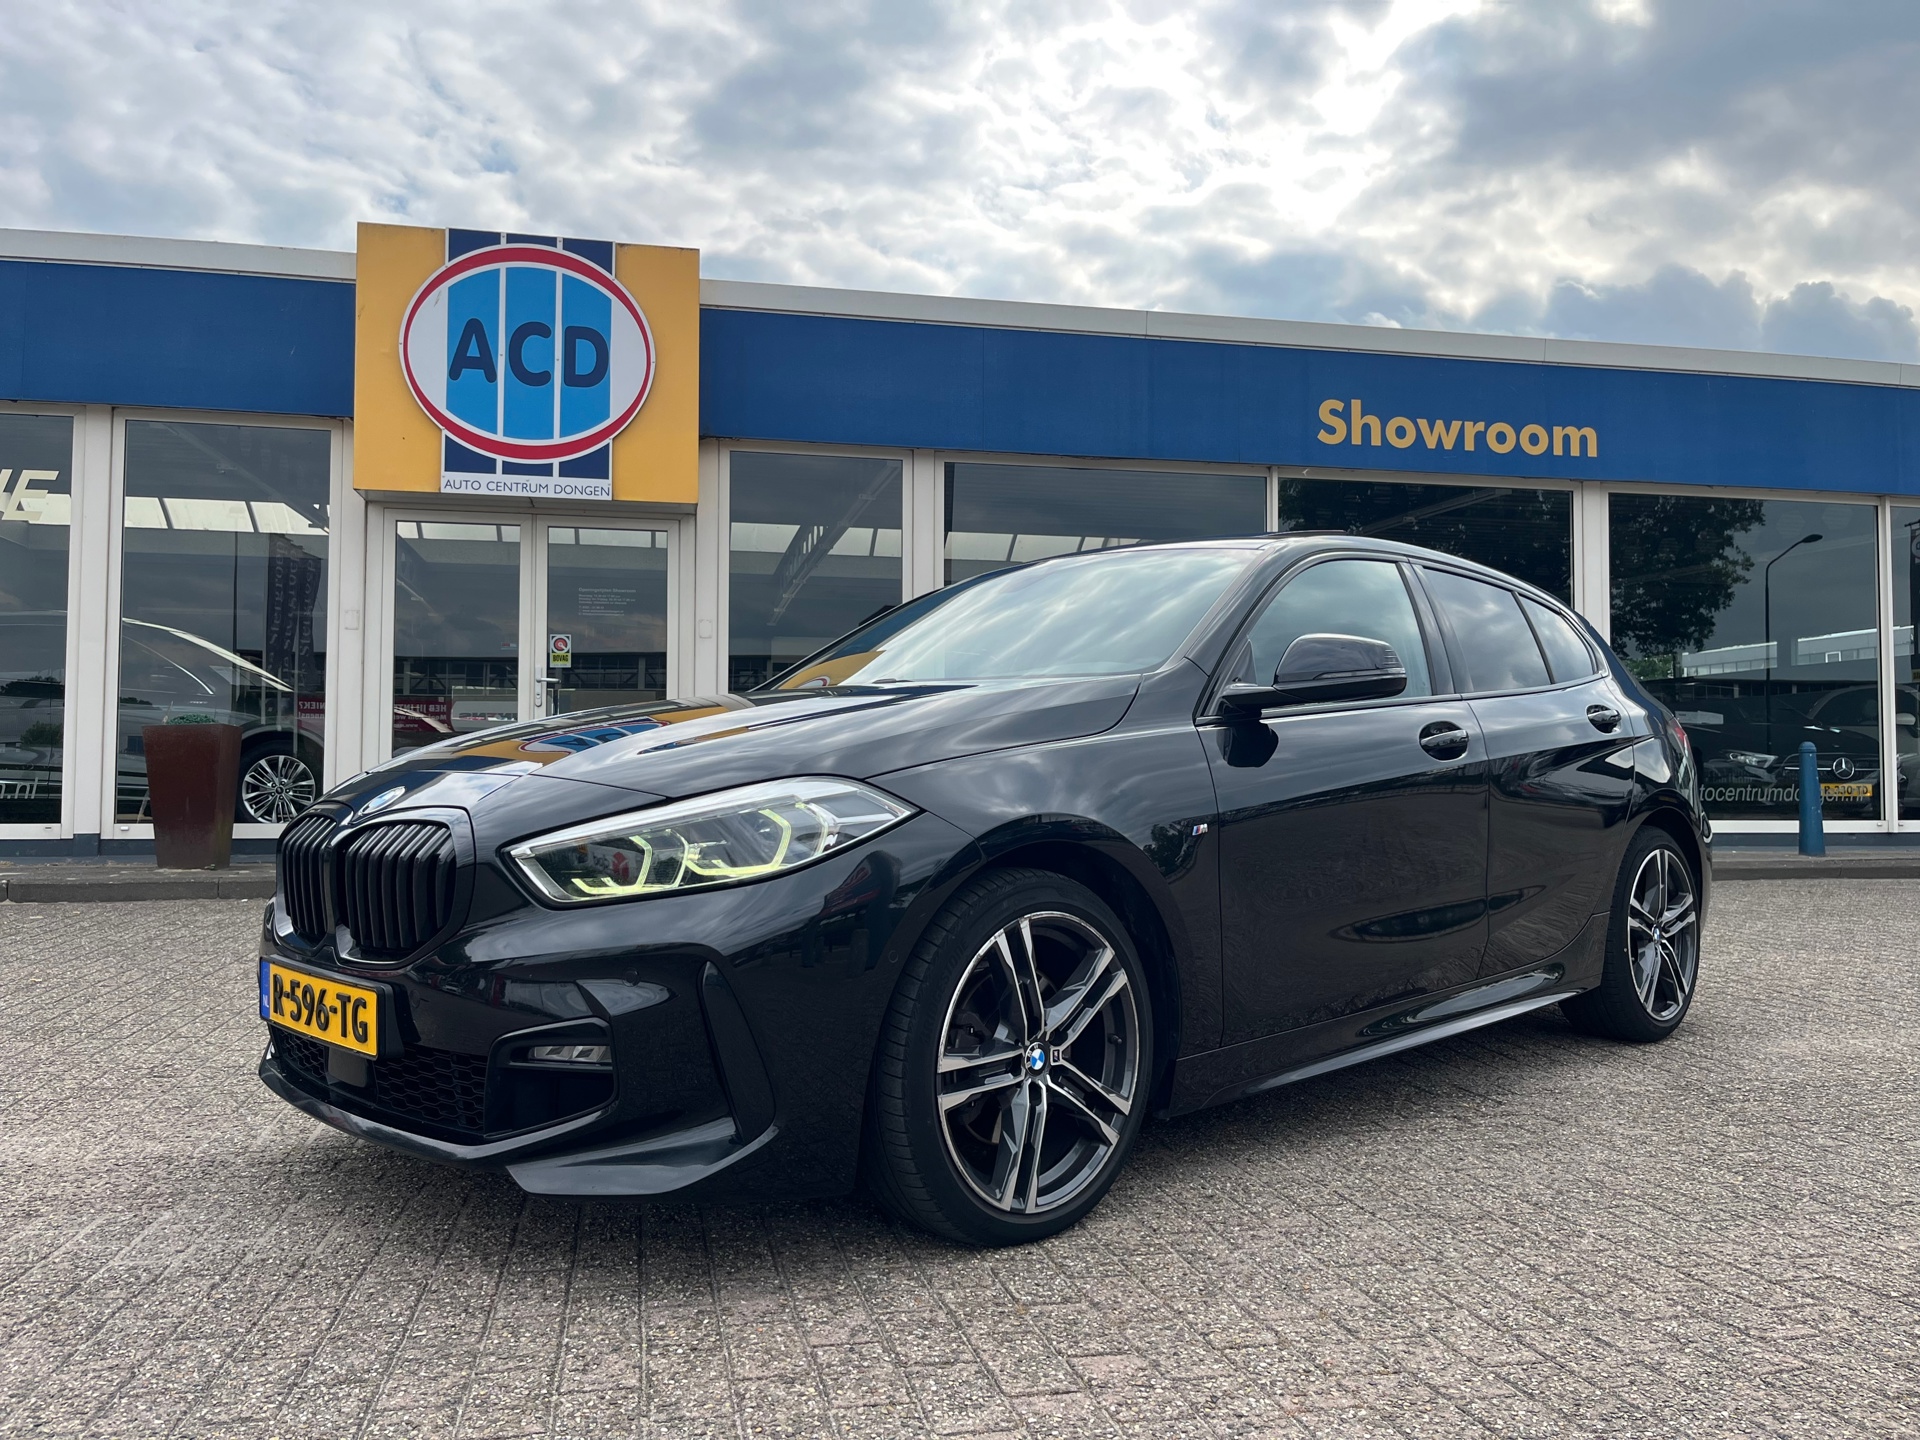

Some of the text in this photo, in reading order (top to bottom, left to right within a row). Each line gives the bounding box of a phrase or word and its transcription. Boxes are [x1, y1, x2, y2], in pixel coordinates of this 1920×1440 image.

[448, 317, 610, 388] ACD
[1316, 398, 1598, 458] Showroom
[444, 479, 610, 497] AUTO CENTRUM DONGEN
[552, 654, 569, 662] BOVAG
[262, 994, 270, 1008] NL
[272, 973, 369, 1044] R-596-TG
